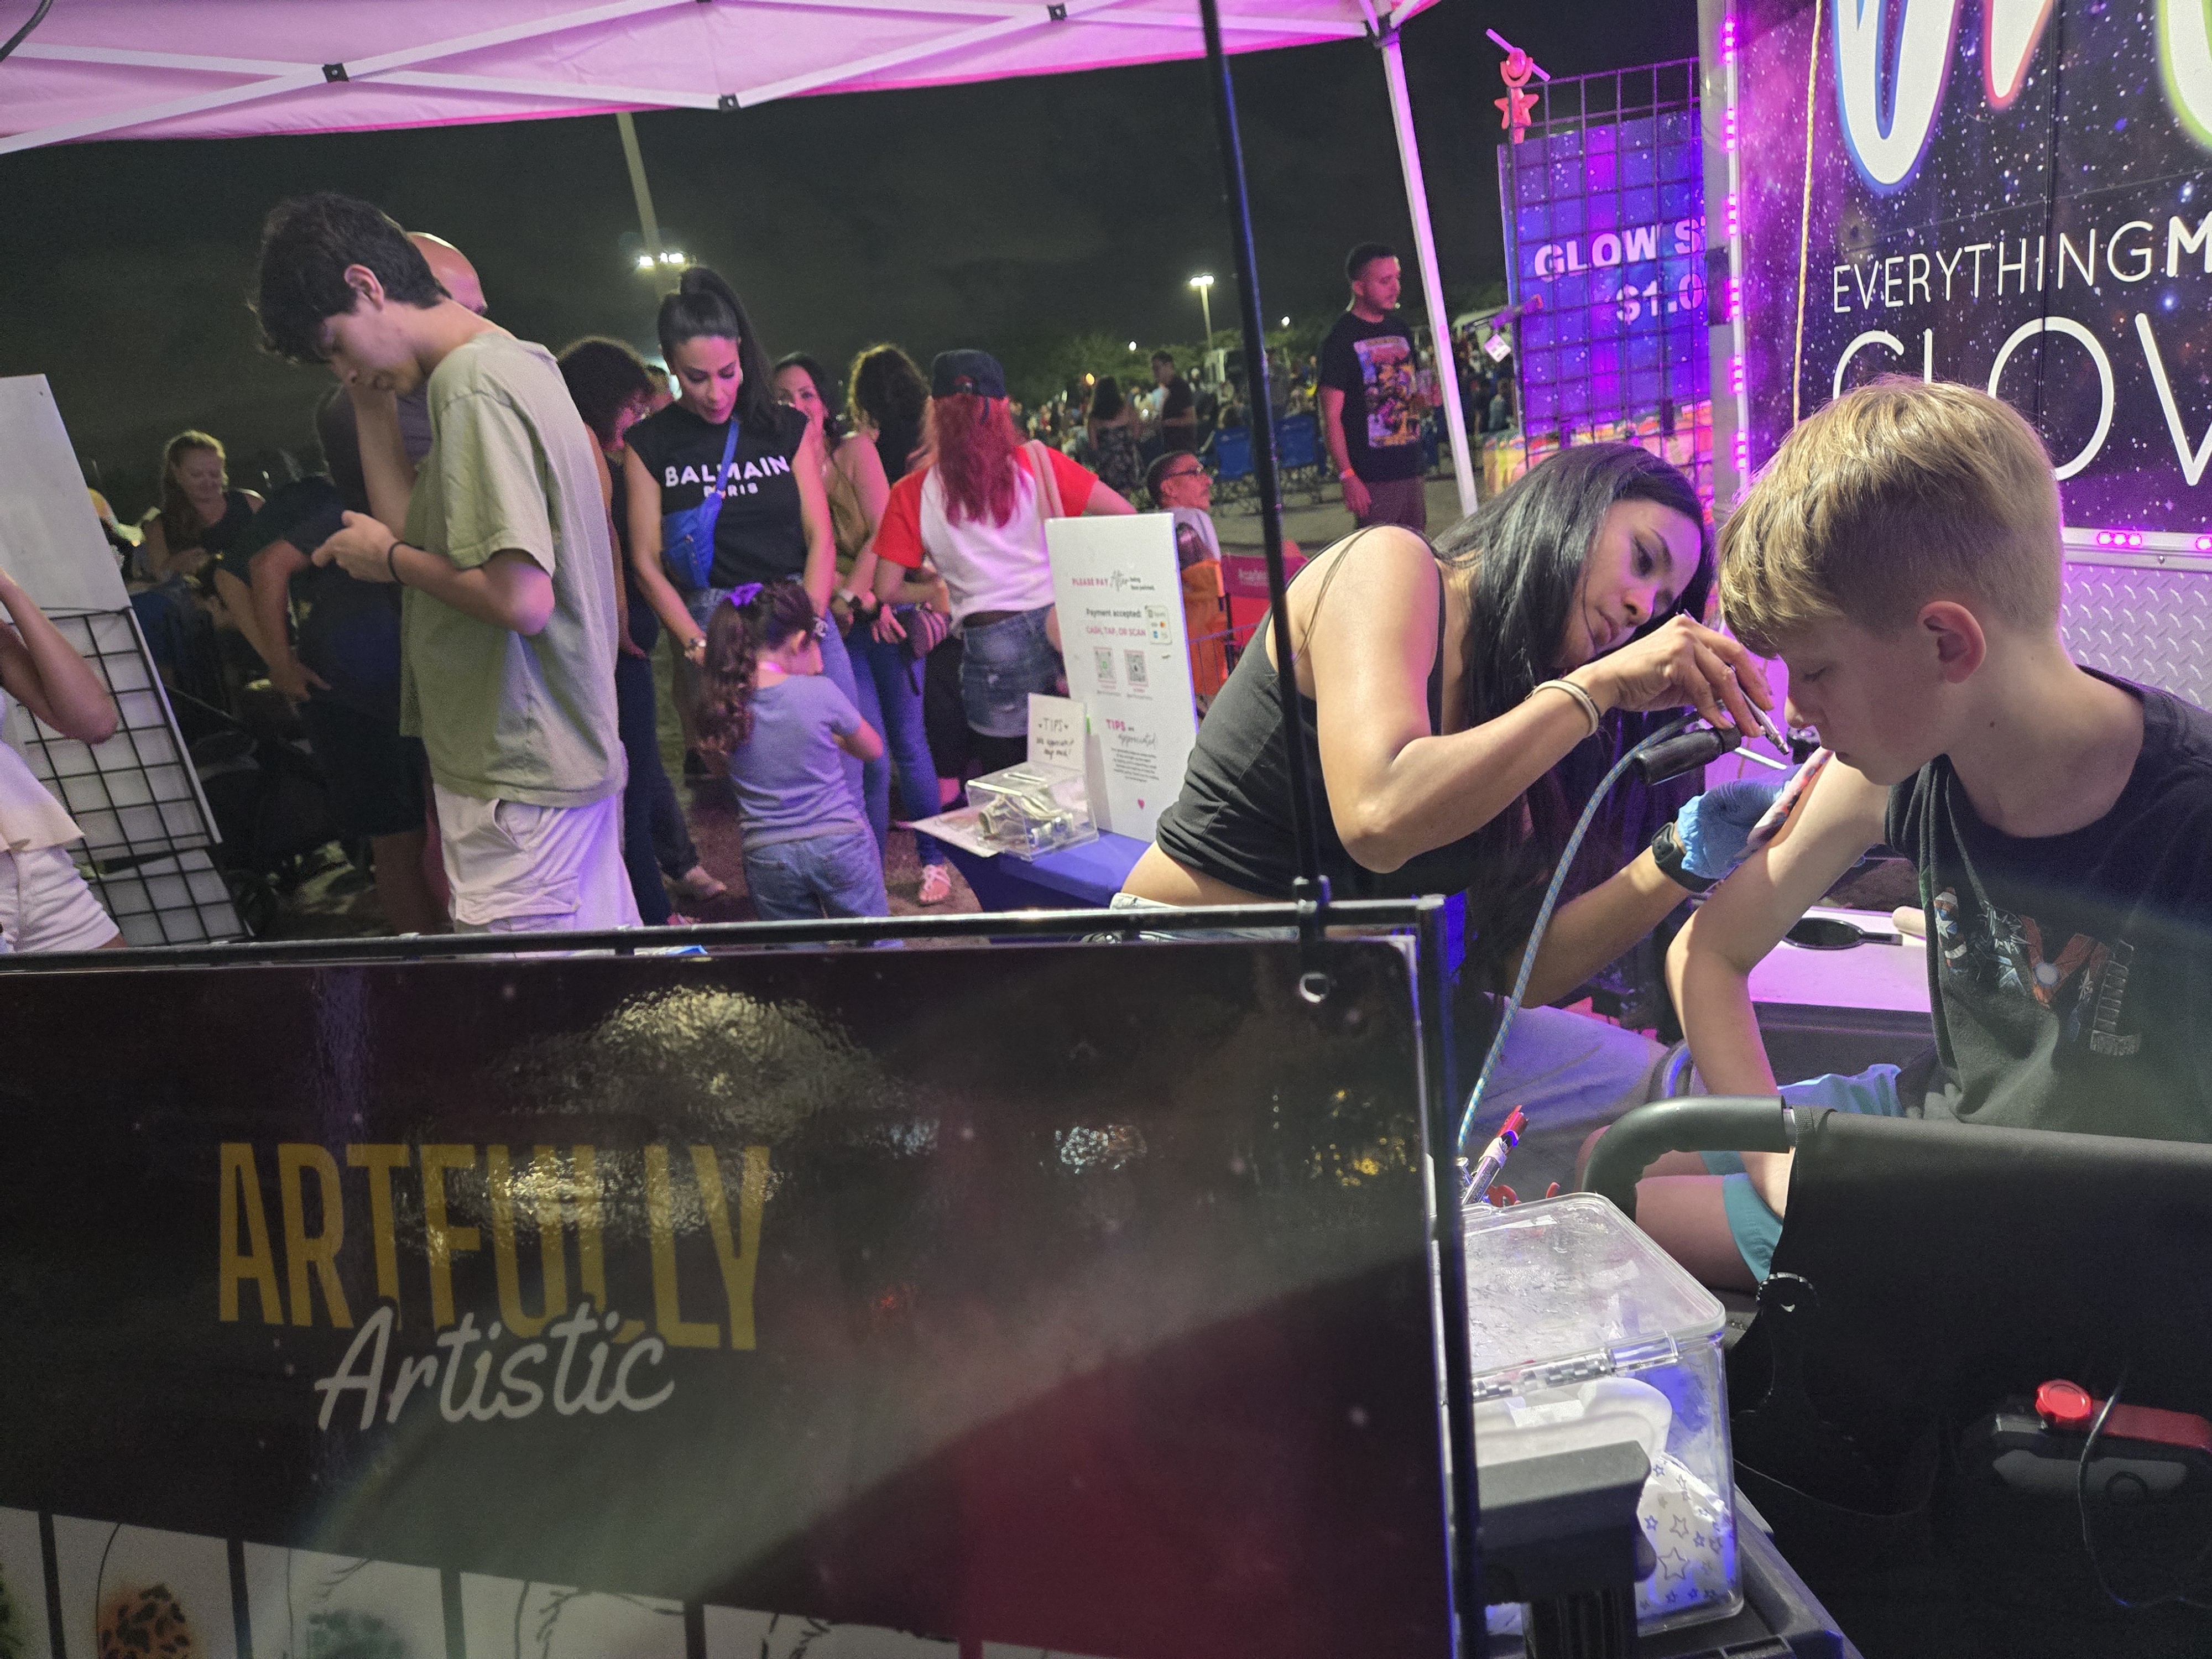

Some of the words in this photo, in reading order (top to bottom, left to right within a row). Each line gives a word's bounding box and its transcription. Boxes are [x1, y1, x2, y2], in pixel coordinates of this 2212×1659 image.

[1535, 225, 1658, 283] GLOW
[1616, 273, 1708, 325] $1.0
[665, 455, 790, 487] BALMAIN
[703, 482, 758, 497] PRIS
[1072, 577, 1093, 586] PLEASE
[1095, 578, 1108, 586] PAY
[1086, 608, 1111, 618] Payment
[1119, 627, 1128, 636] OR
[1128, 628, 1146, 637] SCAN
[1044, 717, 1063, 732] TIPS
[1105, 718, 1126, 732] TIPS
[218, 1142, 771, 1350] ARTFULLY
[314, 1302, 675, 1431] Artistic
